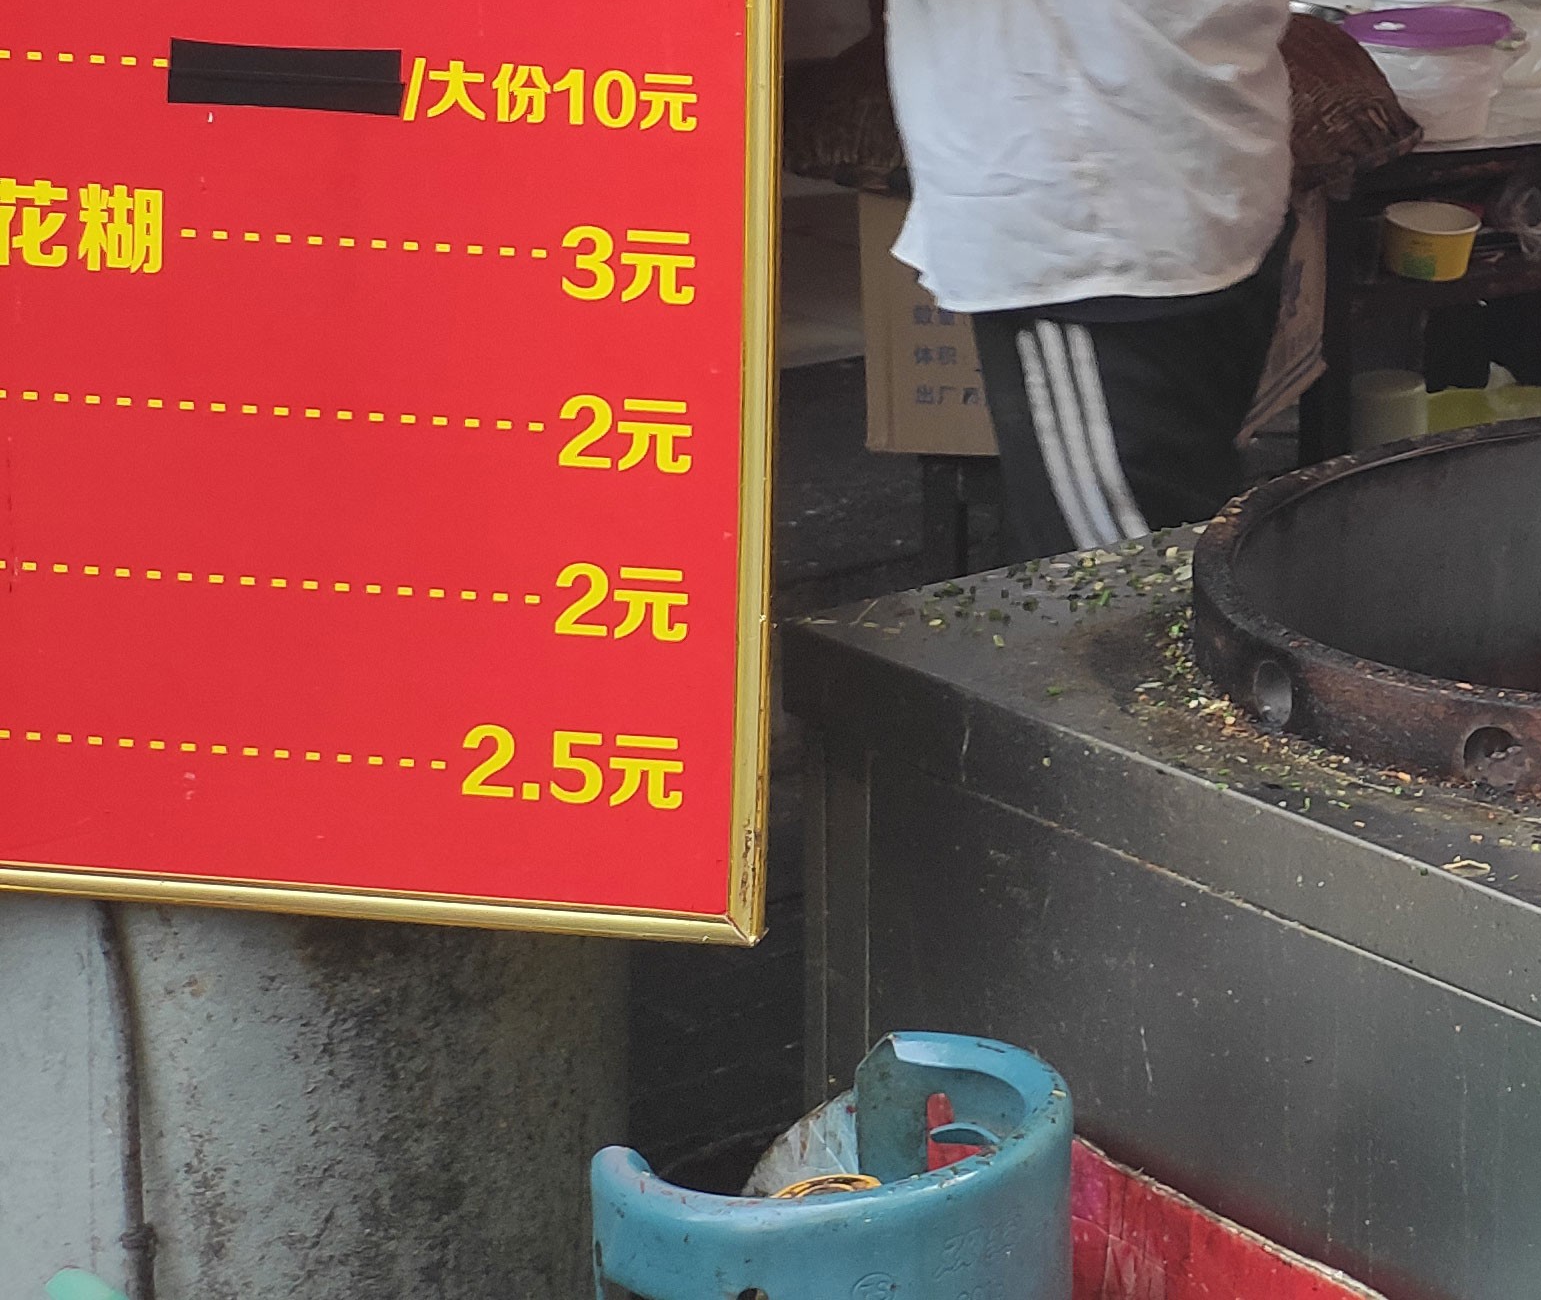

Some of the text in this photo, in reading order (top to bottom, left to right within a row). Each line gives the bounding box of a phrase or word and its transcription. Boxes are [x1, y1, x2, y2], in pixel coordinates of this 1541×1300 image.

[403, 57, 699, 134] /大份10元
[0, 177, 165, 276] 花糊
[561, 225, 697, 307] 3元
[558, 394, 694, 476] 2元
[554, 562, 691, 644] 2元
[461, 724, 686, 811] 2.5元
